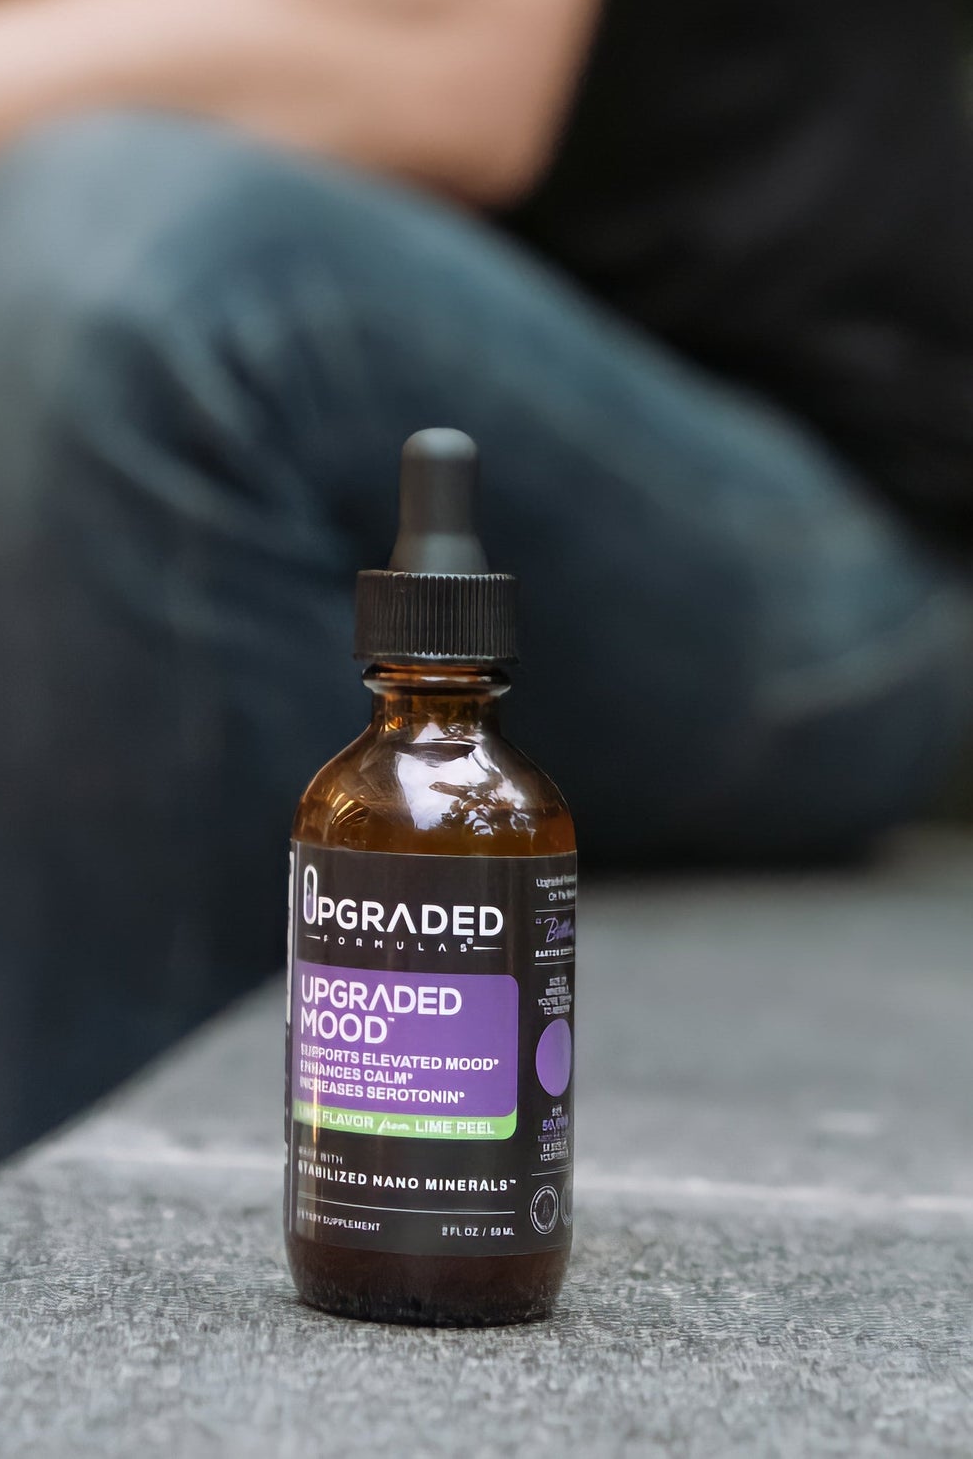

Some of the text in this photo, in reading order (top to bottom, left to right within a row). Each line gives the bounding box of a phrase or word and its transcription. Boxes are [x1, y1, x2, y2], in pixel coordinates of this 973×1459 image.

[303, 864, 504, 936] UPGRADED
[301, 974, 463, 1016] UPGRADED
[300, 1043, 360, 1064] SUPPORTS
[362, 1052, 442, 1070] ELEVATED
[300, 1059, 361, 1081] ENHANCES
[322, 1110, 374, 1129] FLAVOR
[415, 1120, 452, 1134] LIME
[456, 1121, 495, 1135] PEEL
[320, 1152, 343, 1165] WITH
[298, 1159, 367, 1185] STABILIZED
[372, 1174, 419, 1190] NANO
[323, 1215, 381, 1231] SUPPLEMENT
[450, 1226, 462, 1237] FL
[464, 1227, 479, 1237] OZ
